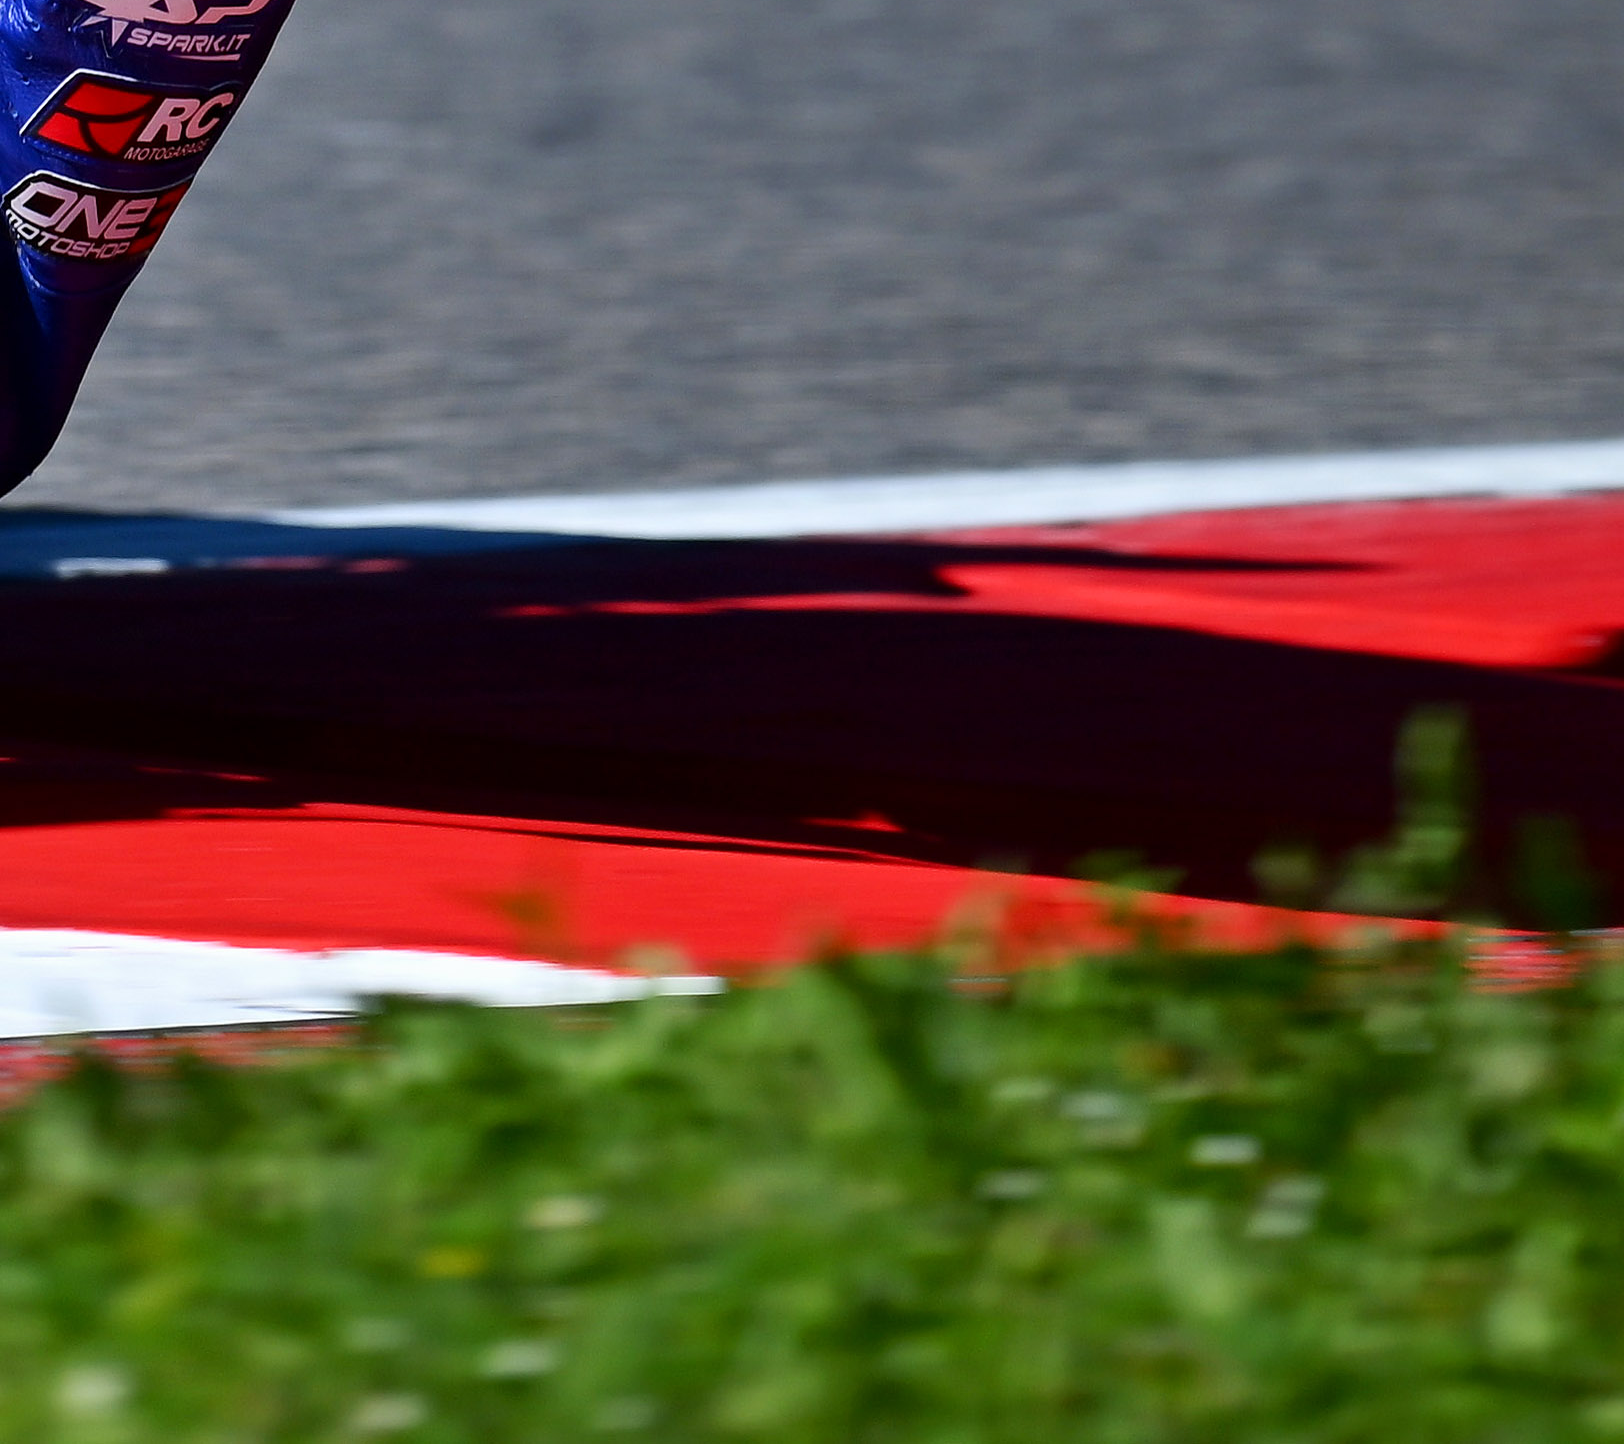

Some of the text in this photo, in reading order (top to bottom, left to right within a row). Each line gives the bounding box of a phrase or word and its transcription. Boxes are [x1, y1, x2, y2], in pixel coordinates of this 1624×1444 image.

[127, 27, 252, 54] SPARK.IT
[138, 93, 234, 143] RC
[5, 209, 131, 261] MOTOSHOP
